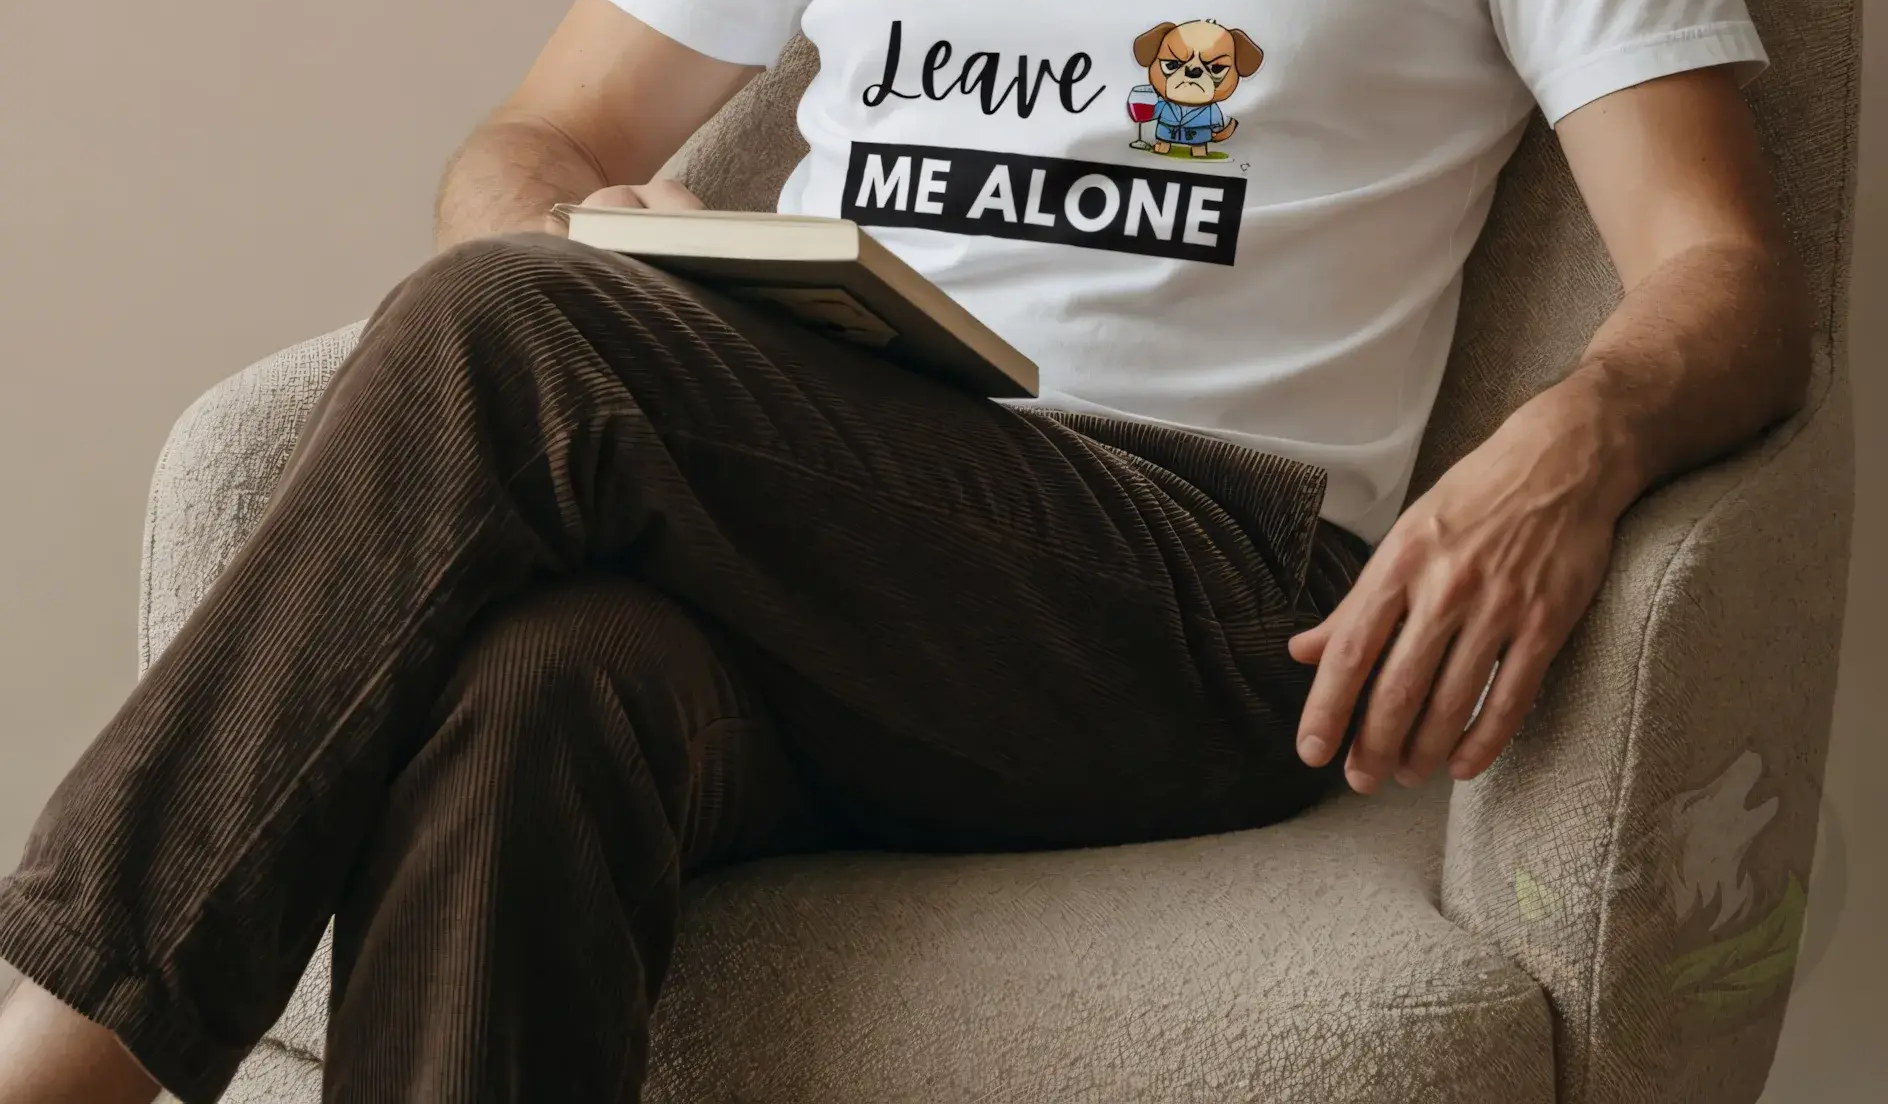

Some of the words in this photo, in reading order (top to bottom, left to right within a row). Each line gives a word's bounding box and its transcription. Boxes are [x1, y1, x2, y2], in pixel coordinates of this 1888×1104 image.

[863, 20, 1106, 119] Leave
[855, 153, 952, 215] ME
[966, 164, 1224, 247] ALONE
